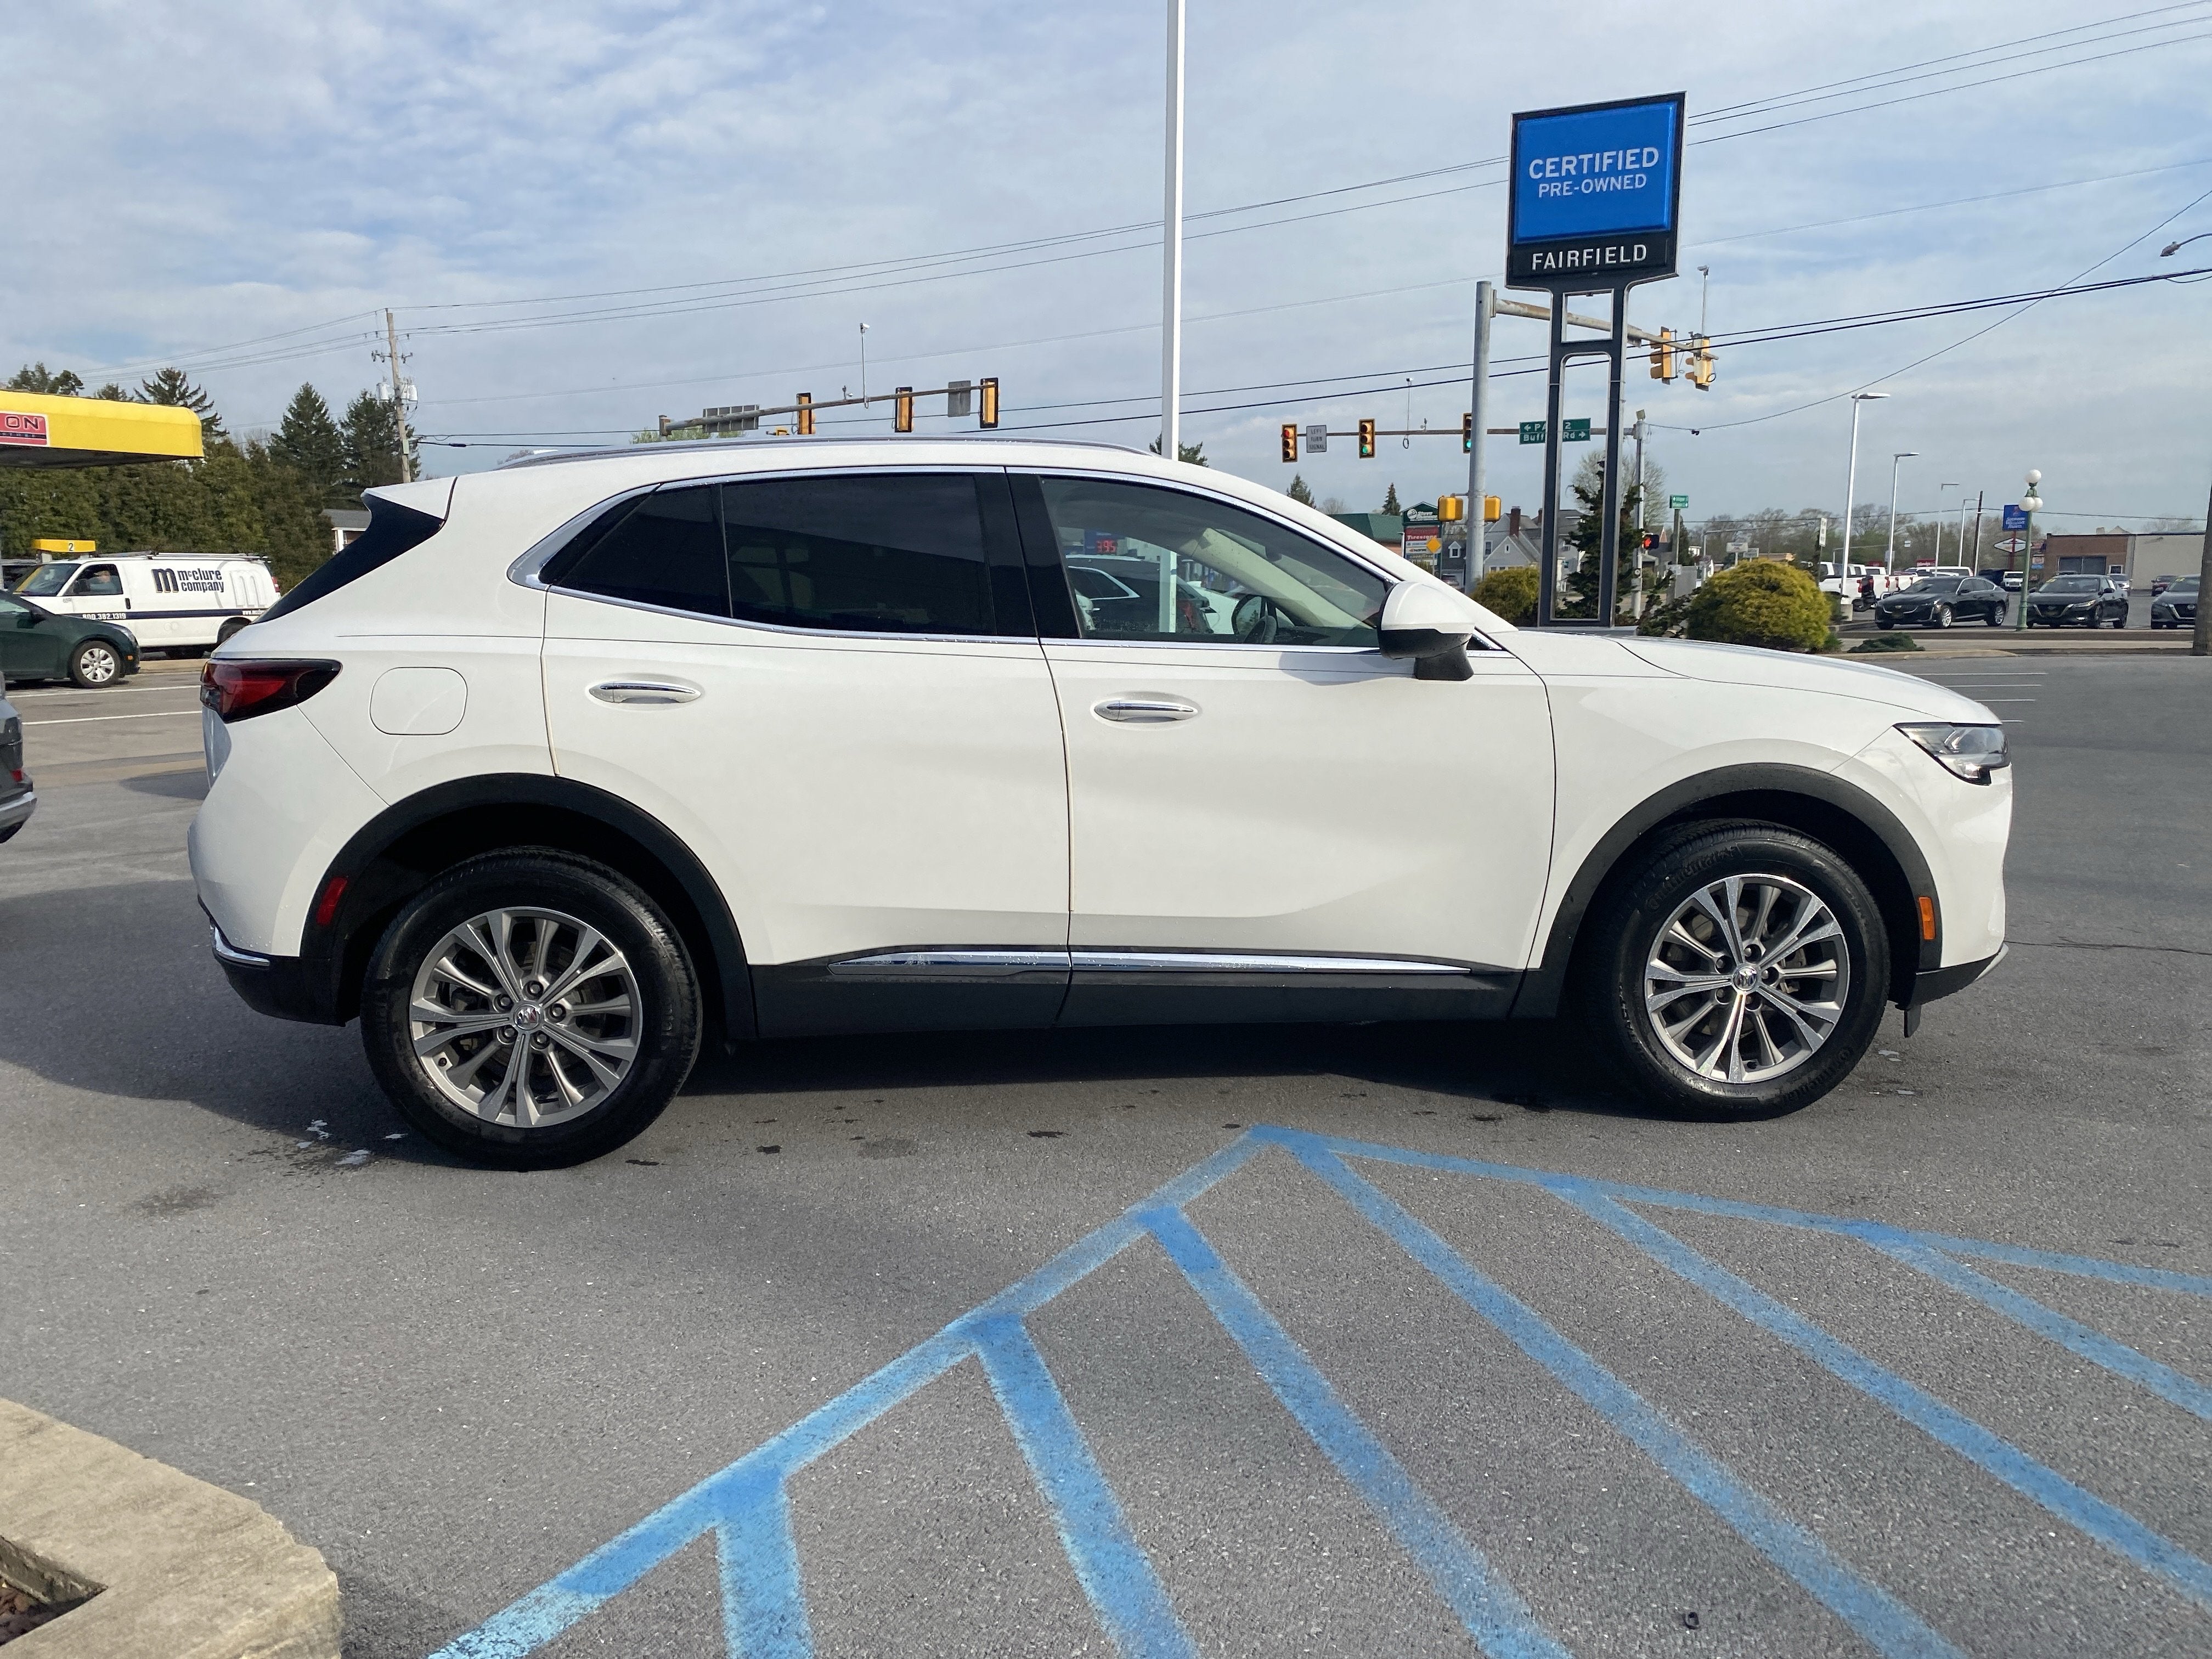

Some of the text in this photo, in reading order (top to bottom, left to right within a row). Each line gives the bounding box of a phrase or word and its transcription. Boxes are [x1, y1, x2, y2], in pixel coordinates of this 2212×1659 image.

[1529, 146, 1660, 179] CERTIFIED
[1538, 173, 1647, 198] PRE-OWNED
[1532, 244, 1647, 270] FAIRFIELD
[69, 543, 74, 551] 2
[180, 581, 224, 593] company
